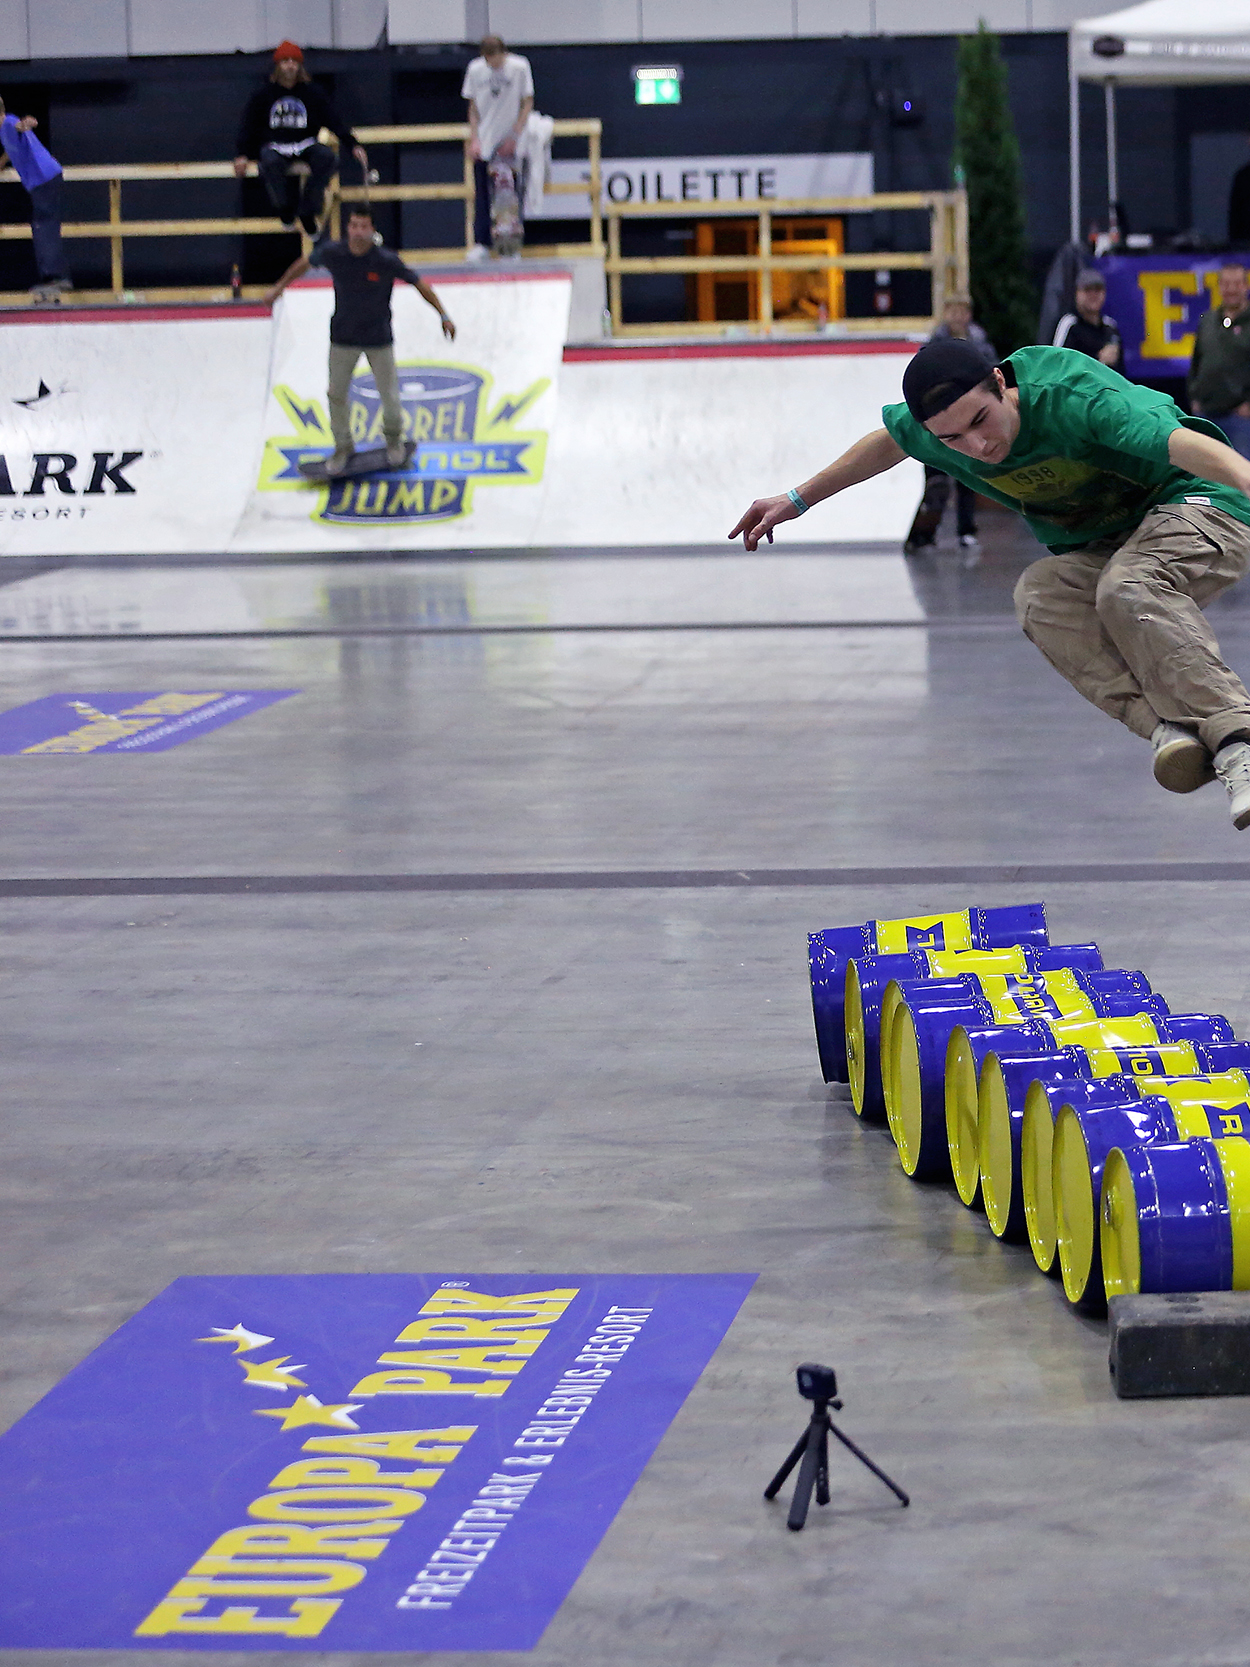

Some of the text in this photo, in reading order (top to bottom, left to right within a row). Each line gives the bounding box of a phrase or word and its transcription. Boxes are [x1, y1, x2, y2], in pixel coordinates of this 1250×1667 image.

[330, 480, 459, 515] JUMP
[1012, 466, 1056, 487] 1998
[133, 1288, 581, 1638] EUROPA PARK
[396, 1305, 654, 1610] FREIZEITPARK & ERLEBNIS-RESORT
